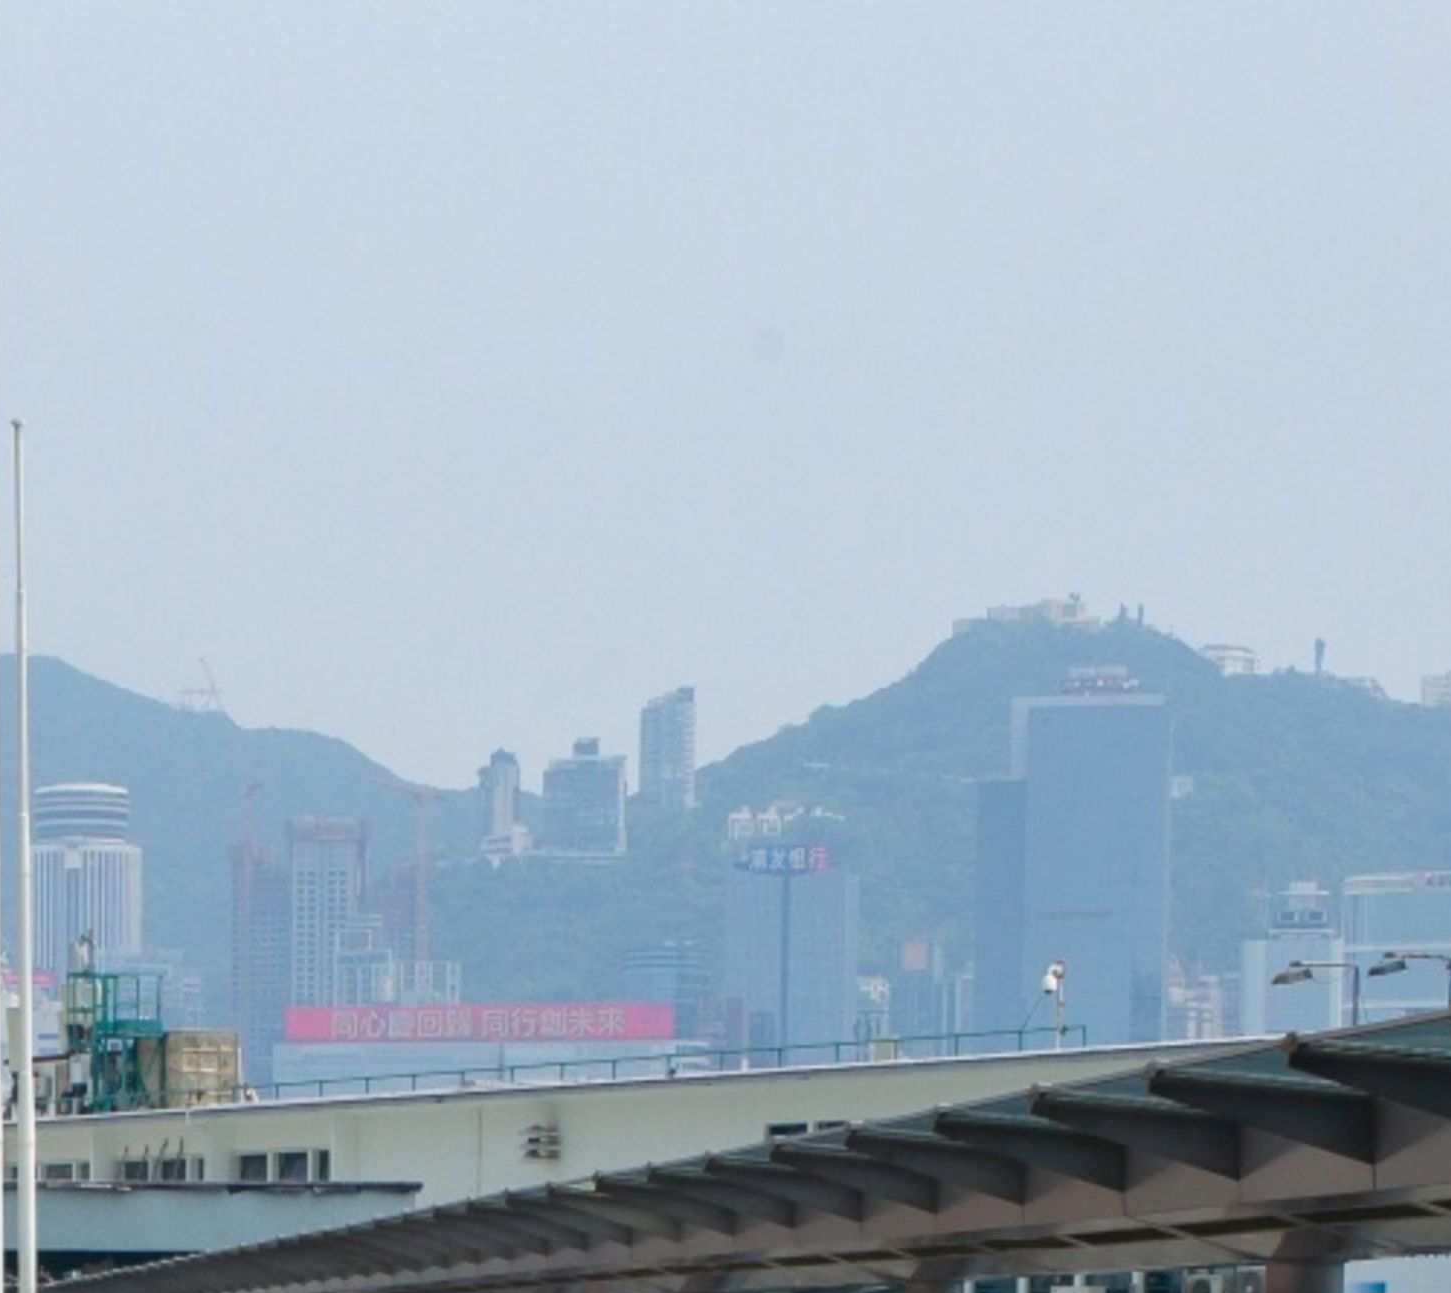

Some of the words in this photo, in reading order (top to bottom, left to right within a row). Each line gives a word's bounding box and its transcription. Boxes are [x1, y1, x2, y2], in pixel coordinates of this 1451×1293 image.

[331, 1009, 472, 1040] 同心慶回歸
[482, 1008, 627, 1038] 同行創未來
